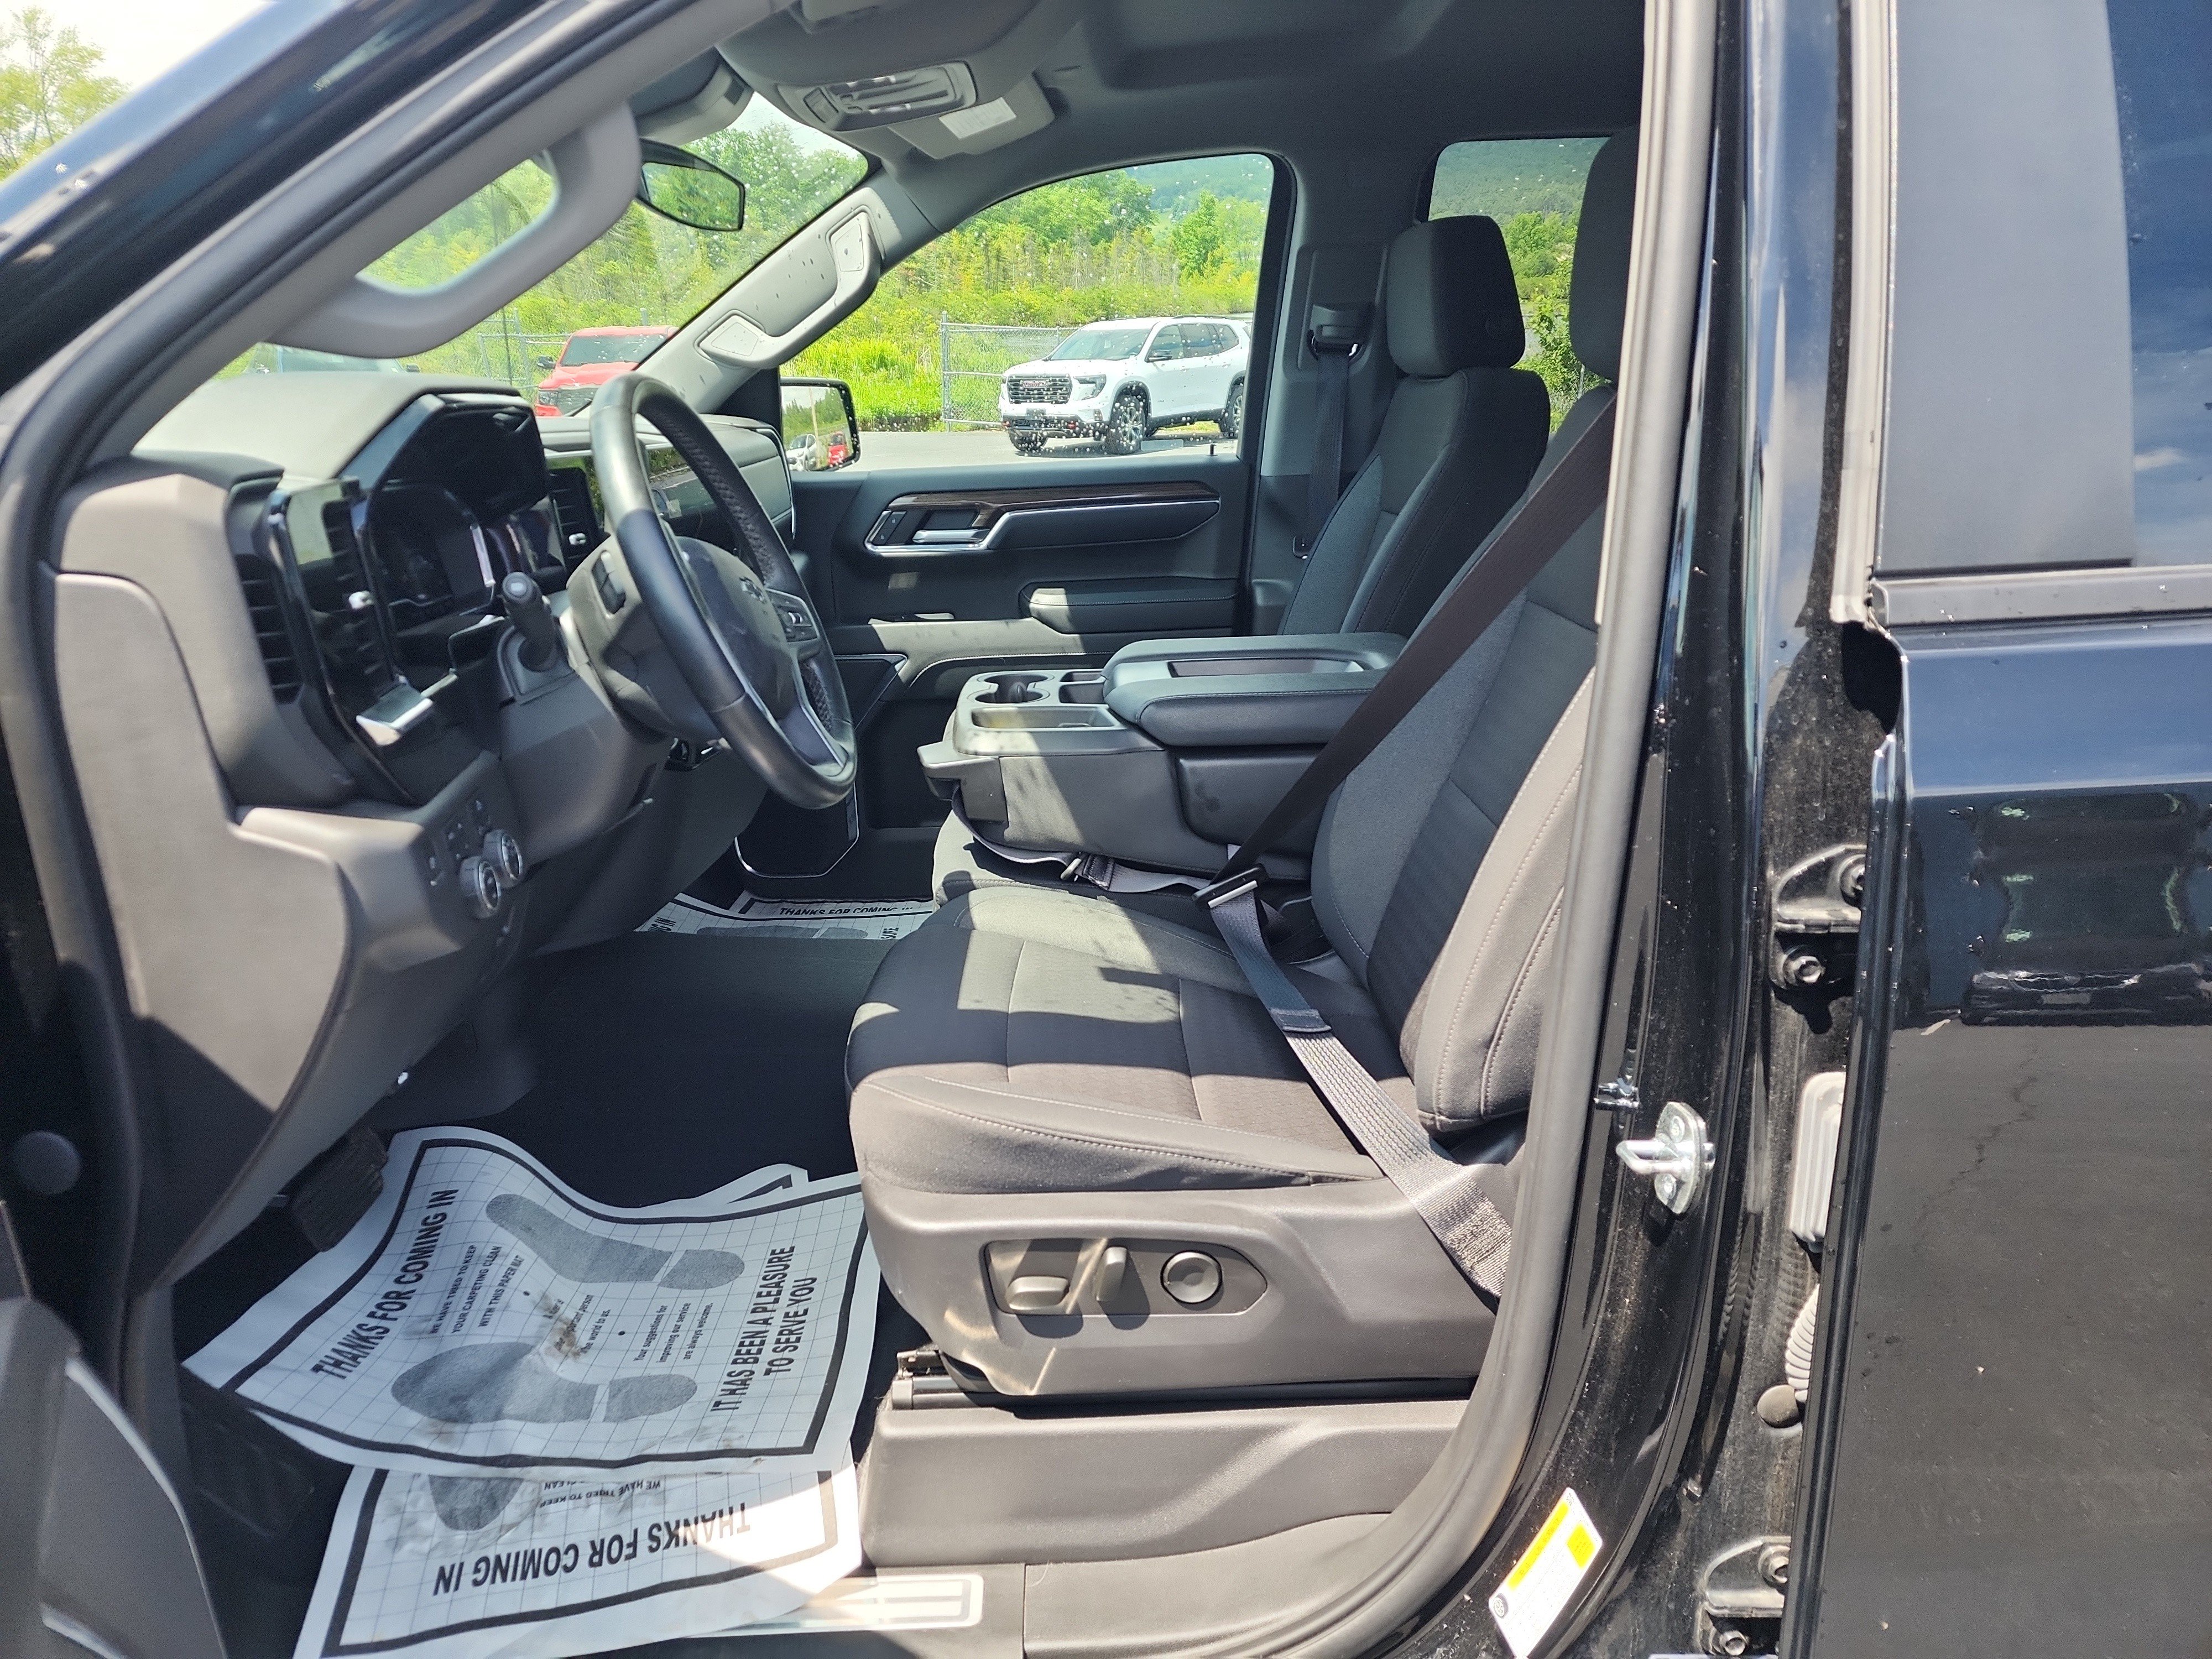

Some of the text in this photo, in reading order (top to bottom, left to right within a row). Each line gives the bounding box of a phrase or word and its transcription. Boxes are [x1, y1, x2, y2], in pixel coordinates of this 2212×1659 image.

[457, 1265, 468, 1276] TO
[462, 1245, 477, 1264] KEEP
[310, 1189, 459, 1379] THANKS FOR COMING IN
[436, 1301, 452, 1321] HAVE
[451, 1246, 503, 1333] YOUR CARPETING CLEAN
[478, 1255, 525, 1327] WITH THIS PAPER MAT
[429, 1323, 442, 1334] WE
[587, 1324, 603, 1340] world
[633, 1305, 668, 1361] Your suggestions for
[656, 1303, 691, 1363] improving our service
[684, 1303, 713, 1360] are always welcome.
[710, 1245, 796, 1412] IT HAS BEEN A PLEASURE
[763, 1277, 817, 1376] TO SERVE YOU
[540, 1496, 567, 1509] KEEP
[619, 1479, 644, 1496] HAVE
[646, 1480, 661, 1490] WE
[432, 1502, 751, 1597] THANKS FOR COMING IN
